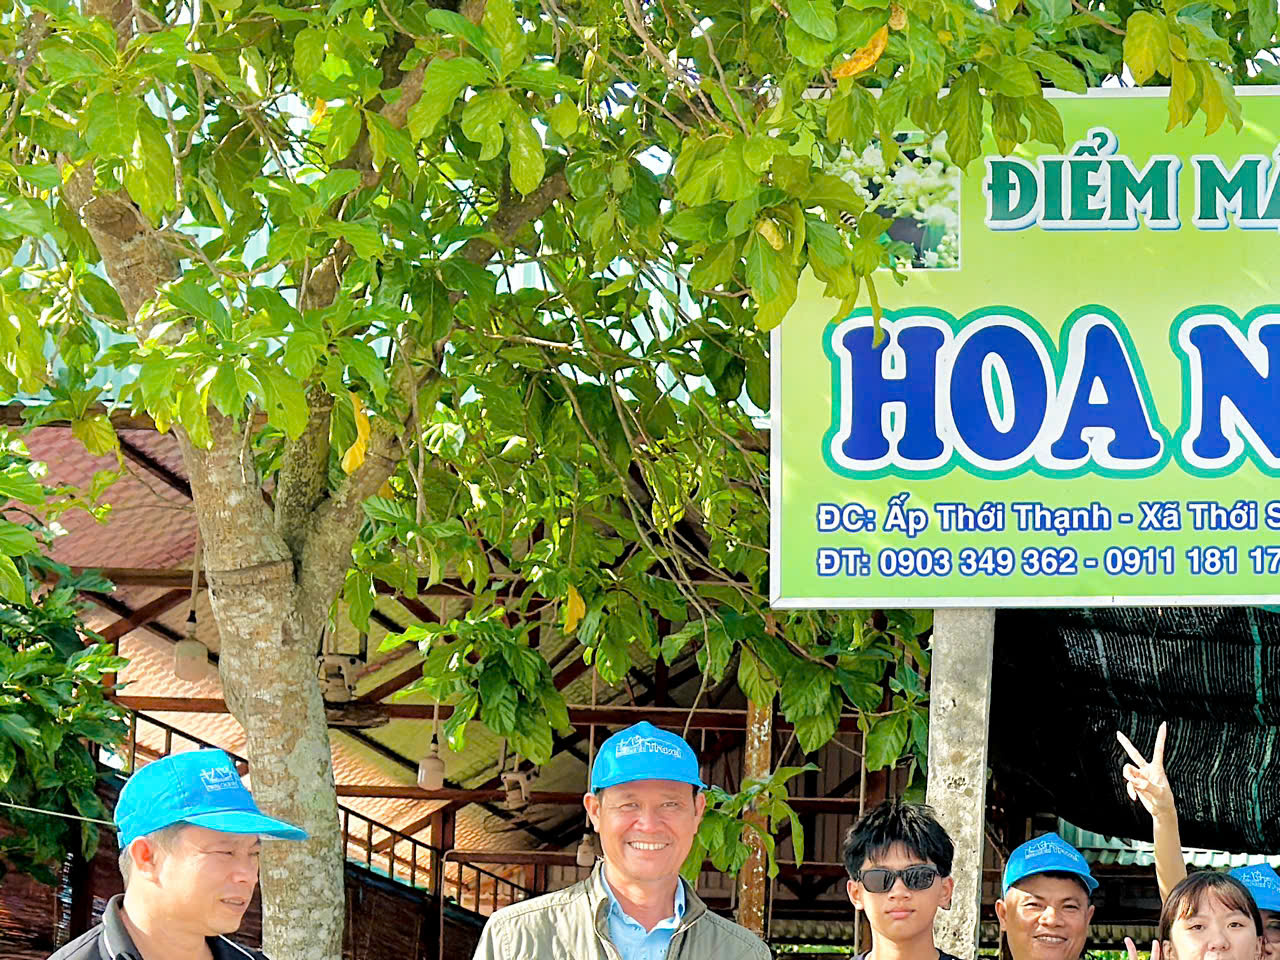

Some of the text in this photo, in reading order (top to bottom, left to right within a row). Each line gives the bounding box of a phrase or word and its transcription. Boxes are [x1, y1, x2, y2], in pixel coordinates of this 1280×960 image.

[984, 127, 1180, 231] ĐIỂM
[830, 314, 1168, 472] HOA
[817, 503, 876, 532] ĐC:
[883, 492, 928, 537] Ấp
[935, 502, 1005, 532] Thới
[1012, 502, 1111, 536] Thạnh
[1139, 502, 1182, 531] Xã
[1188, 500, 1258, 531] Thới
[817, 547, 870, 576] ĐT:
[879, 547, 952, 576] 0903
[959, 547, 1014, 576] 349
[1021, 547, 1078, 575] 362
[1104, 546, 1175, 575] 0911
[1187, 546, 1237, 575] 181
